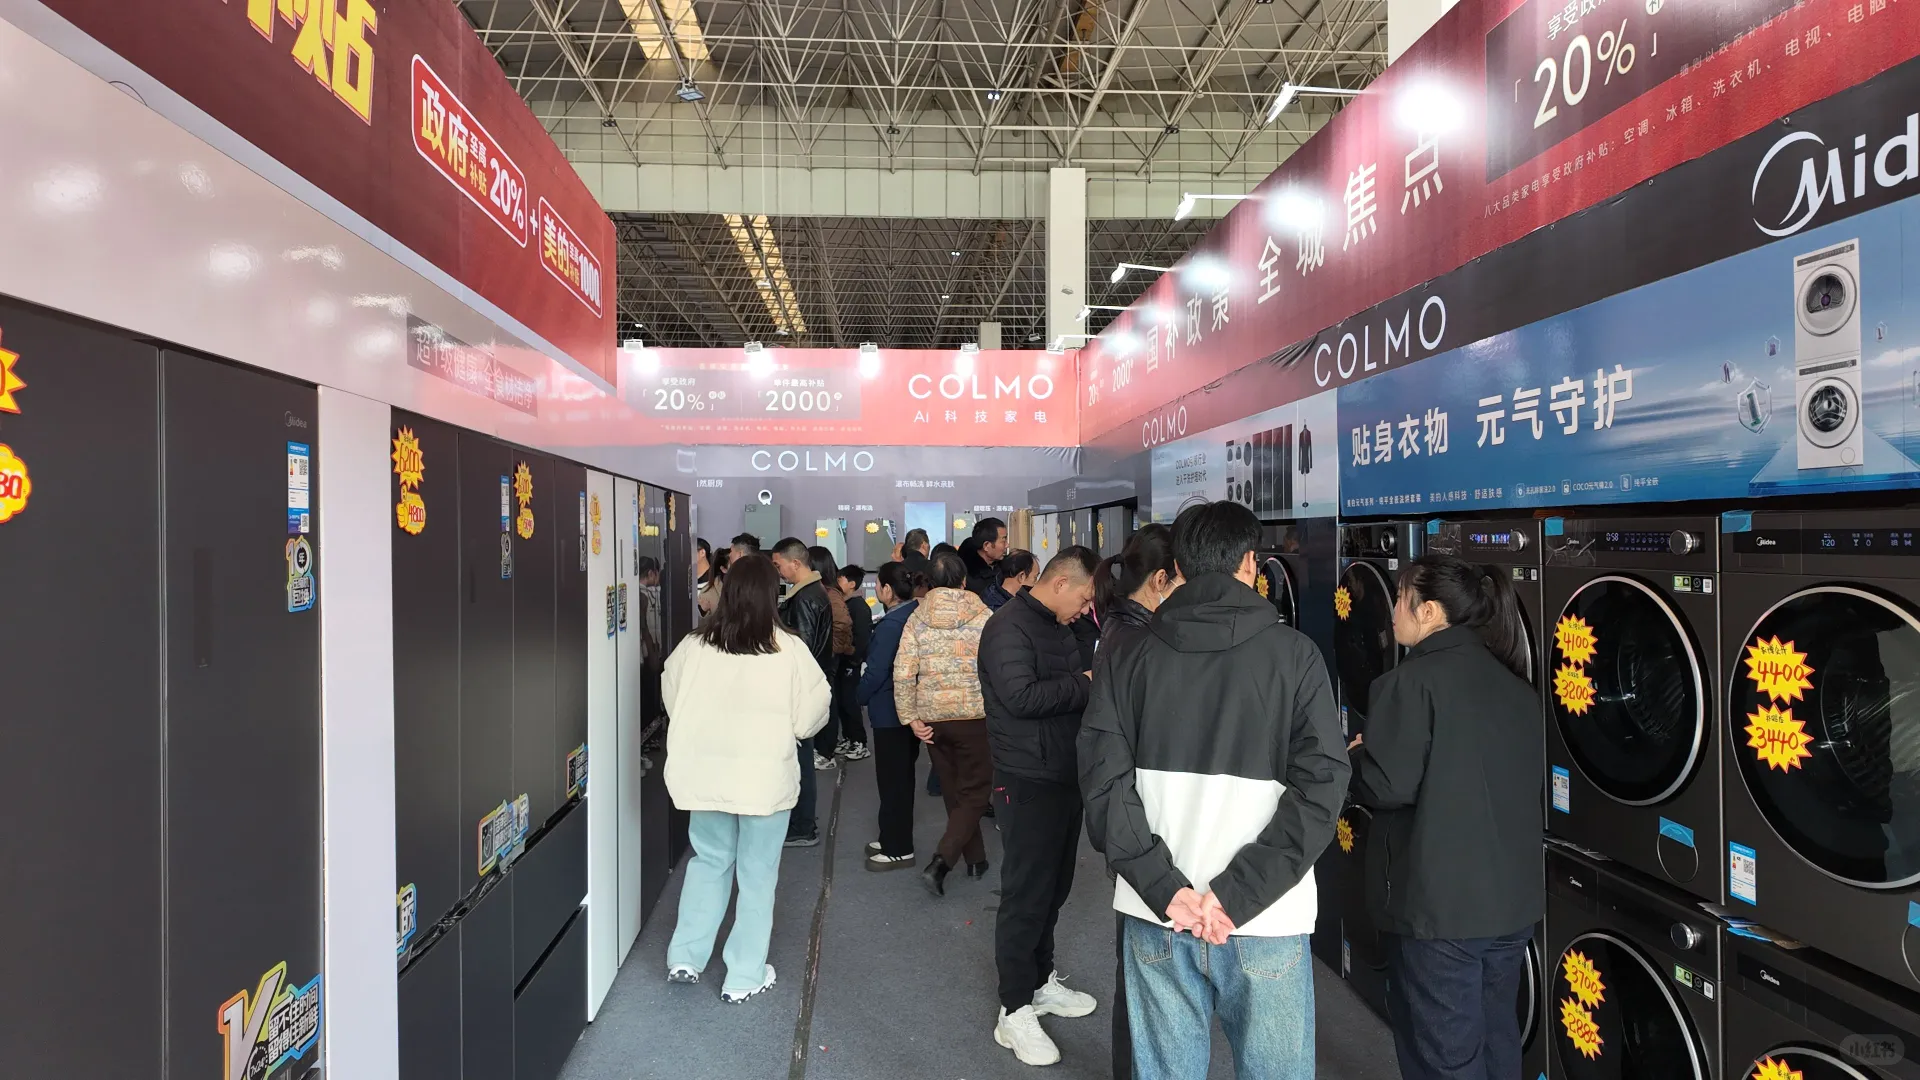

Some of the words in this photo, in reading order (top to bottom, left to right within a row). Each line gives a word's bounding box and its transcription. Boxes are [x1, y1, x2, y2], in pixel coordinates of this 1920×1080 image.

[1534, 18, 1636, 130] 20%
[421, 80, 468, 178] 政府
[470, 131, 487, 168] 至高
[470, 161, 487, 196] 补贴
[490, 157, 525, 230] 20%
[543, 213, 570, 278] 美的
[1314, 295, 1447, 388] COLMO
[654, 389, 705, 411] 20%
[765, 390, 831, 412] 2000
[908, 374, 1054, 400] COLMO
[944, 410, 1048, 423] 科技家电
[1142, 405, 1187, 448] COLMO
[1352, 407, 1449, 467] 贴身衣物
[1477, 364, 1634, 448] 元气守护
[751, 450, 874, 471] COLMO
[697, 479, 723, 488] 然厨房
[1755, 536, 1776, 547] Midea
[1563, 632, 1589, 651] 4100
[1757, 660, 1805, 685] 4400
[1561, 679, 1589, 700] 3200
[1755, 726, 1799, 755] 3440
[1571, 964, 1598, 995] 3700
